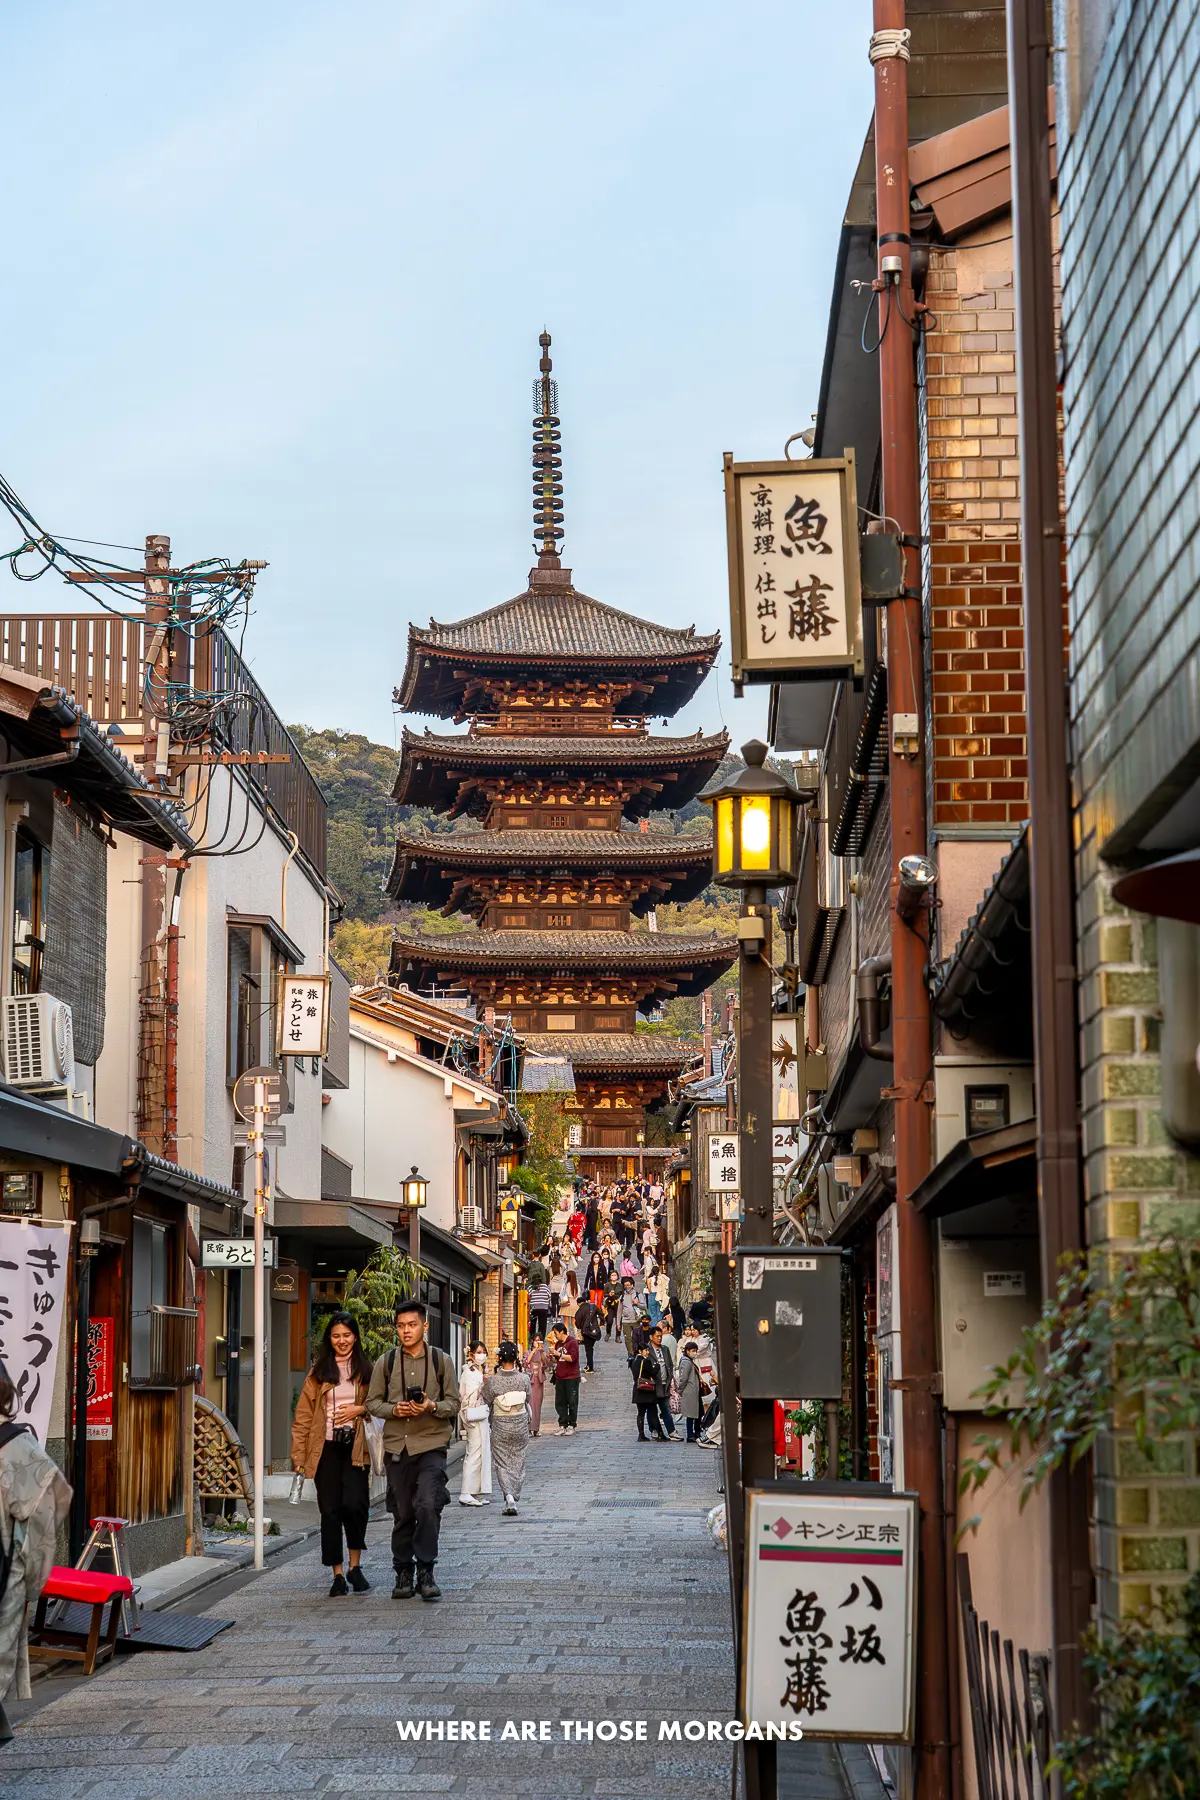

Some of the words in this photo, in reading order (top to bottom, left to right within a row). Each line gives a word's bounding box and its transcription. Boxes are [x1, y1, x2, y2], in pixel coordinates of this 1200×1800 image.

[780, 495, 839, 642] 魚藤
[288, 998, 303, 1041] ちとせ
[306, 989, 319, 1017] 旅館
[774, 1134, 794, 1147] 24
[721, 1142, 737, 1182] 魚捨
[206, 1243, 225, 1253] 民宿
[17, 1244, 61, 1414] きゅうり
[794, 1521, 900, 1544] キンシ正宗
[838, 1575, 886, 1666] 八坂
[779, 1588, 834, 1716] 魚藤
